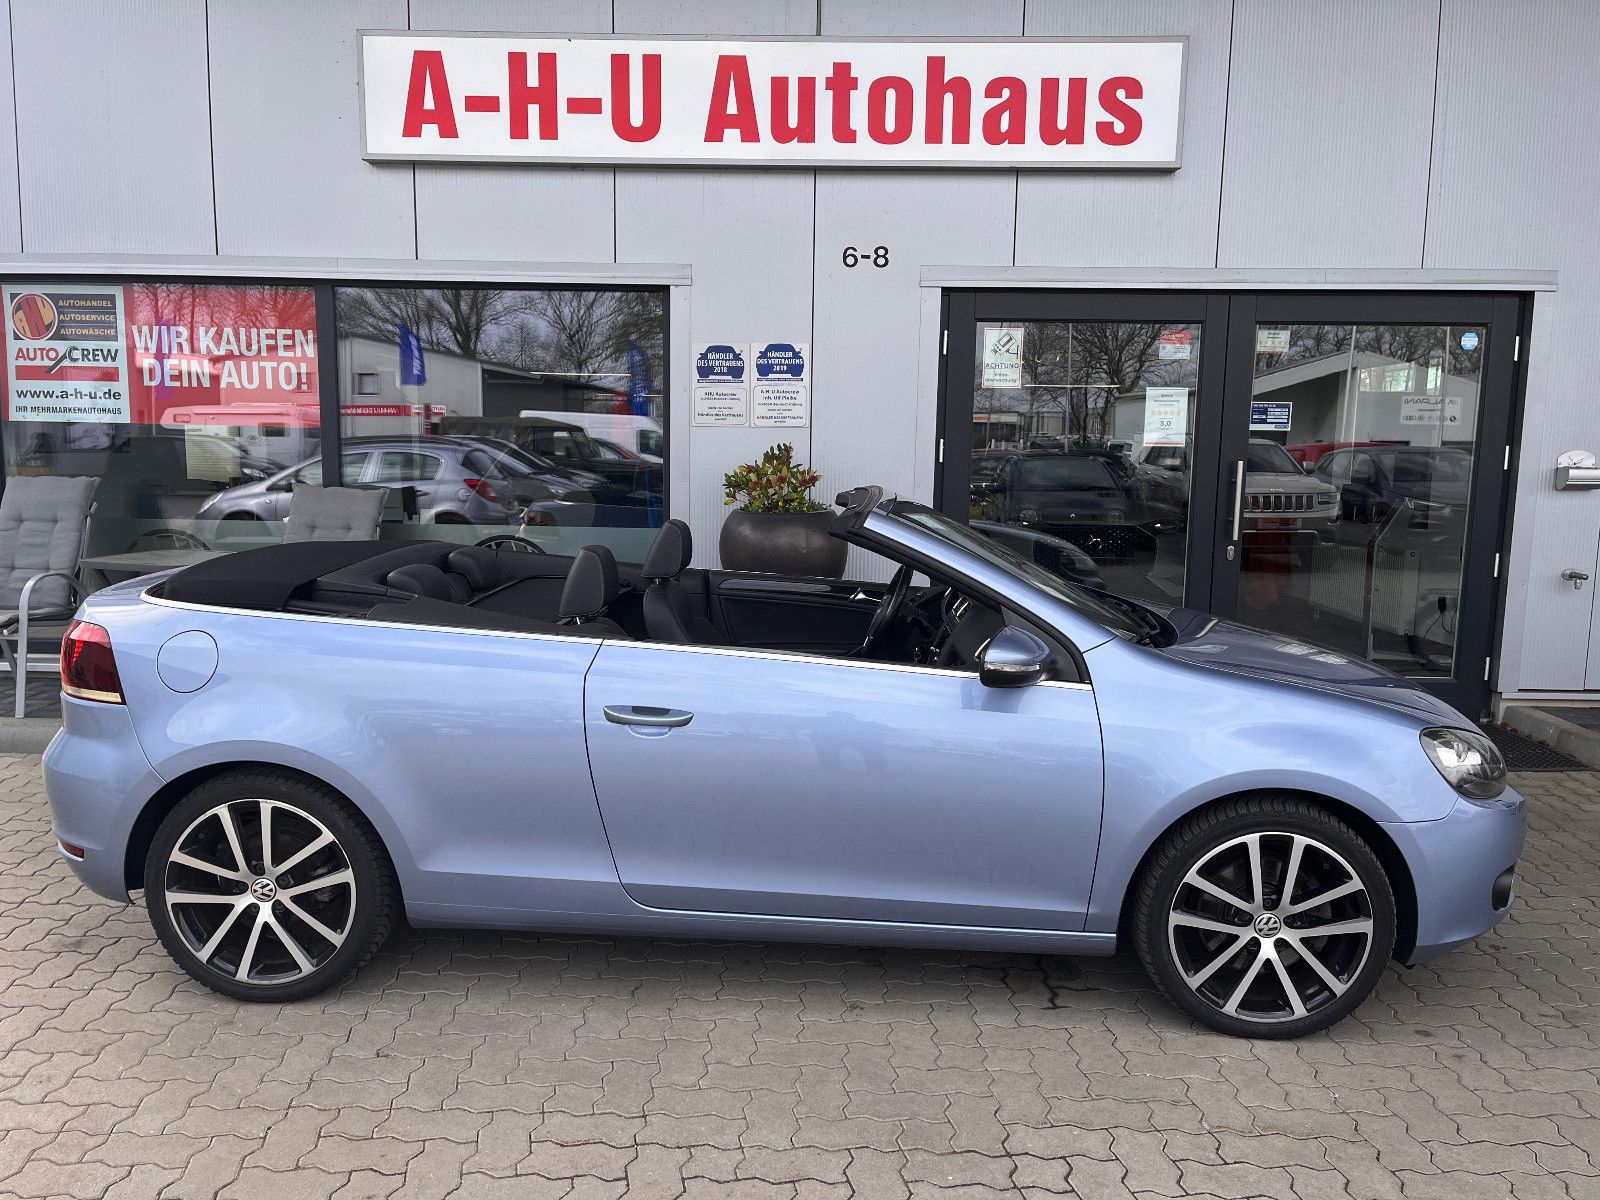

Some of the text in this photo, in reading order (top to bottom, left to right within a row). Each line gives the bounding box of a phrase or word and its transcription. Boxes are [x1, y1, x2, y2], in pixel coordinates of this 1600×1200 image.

[402, 50, 1144, 147] A-H-U Autohaus
[842, 246, 889, 268] 6-8
[60, 327, 116, 336] AUTOWÄSCHE
[132, 325, 315, 358] WIR KAUFEN
[15, 347, 119, 362] AUTO CREW
[707, 352, 734, 360] HÄNDLER
[143, 359, 309, 390] DEIN AUTO!
[16, 388, 122, 400] www.a-h-u.de
[30, 406, 122, 415] MEHRMARKENAUTOHAUS
[1159, 420, 1172, 428] 5,0
